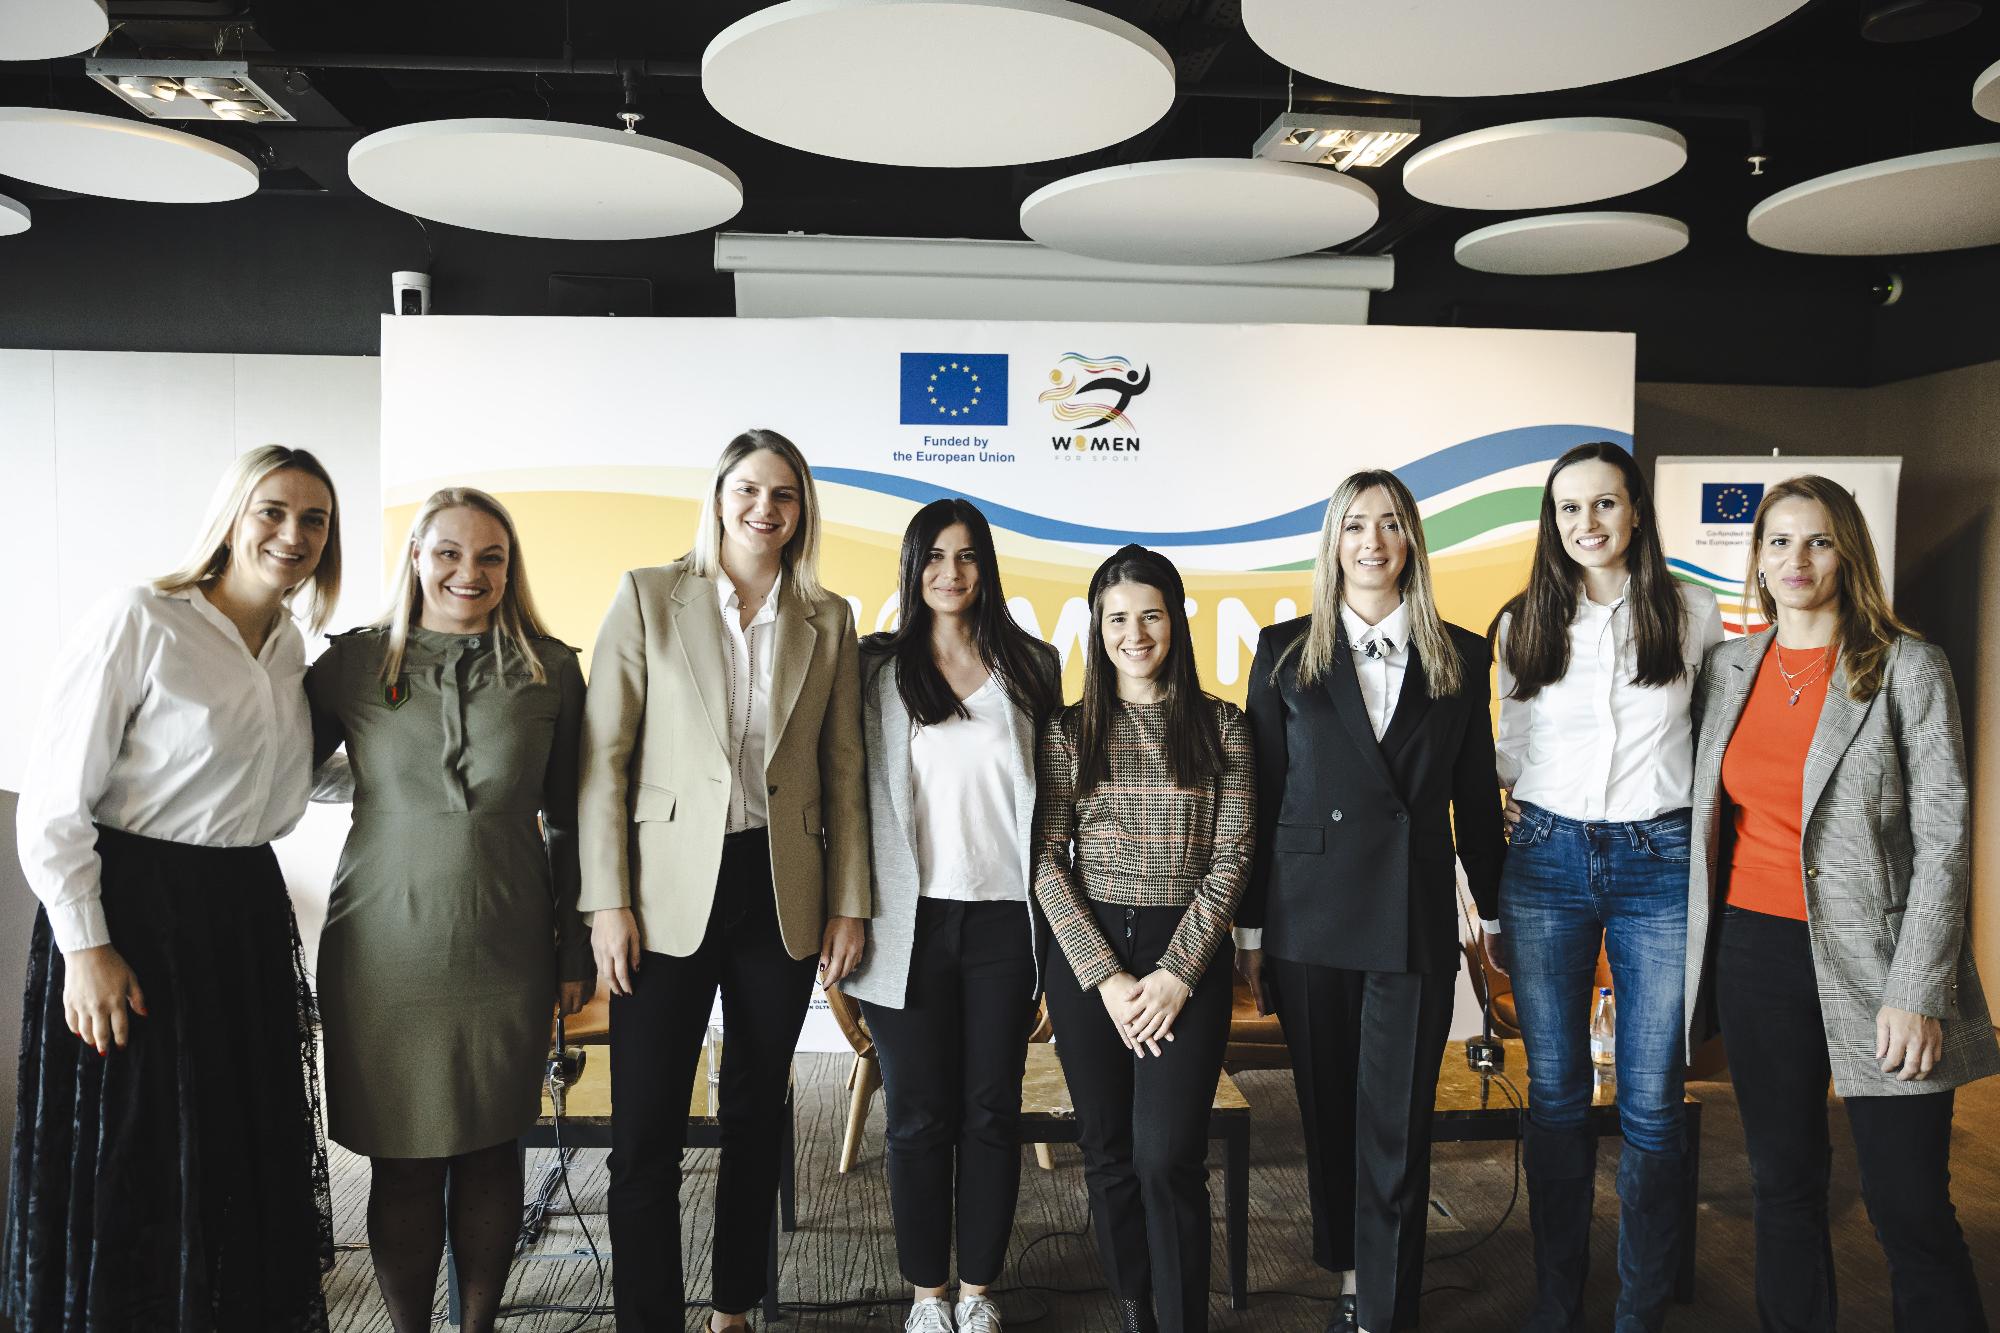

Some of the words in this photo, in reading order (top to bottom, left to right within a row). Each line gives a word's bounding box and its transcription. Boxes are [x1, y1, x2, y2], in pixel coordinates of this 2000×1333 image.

[924, 435, 970, 446] Funded
[974, 436, 989, 449] by
[1052, 435, 1140, 452] WOMEN
[893, 451, 912, 461] the
[916, 451, 975, 464] European
[979, 451, 1015, 463] Union
